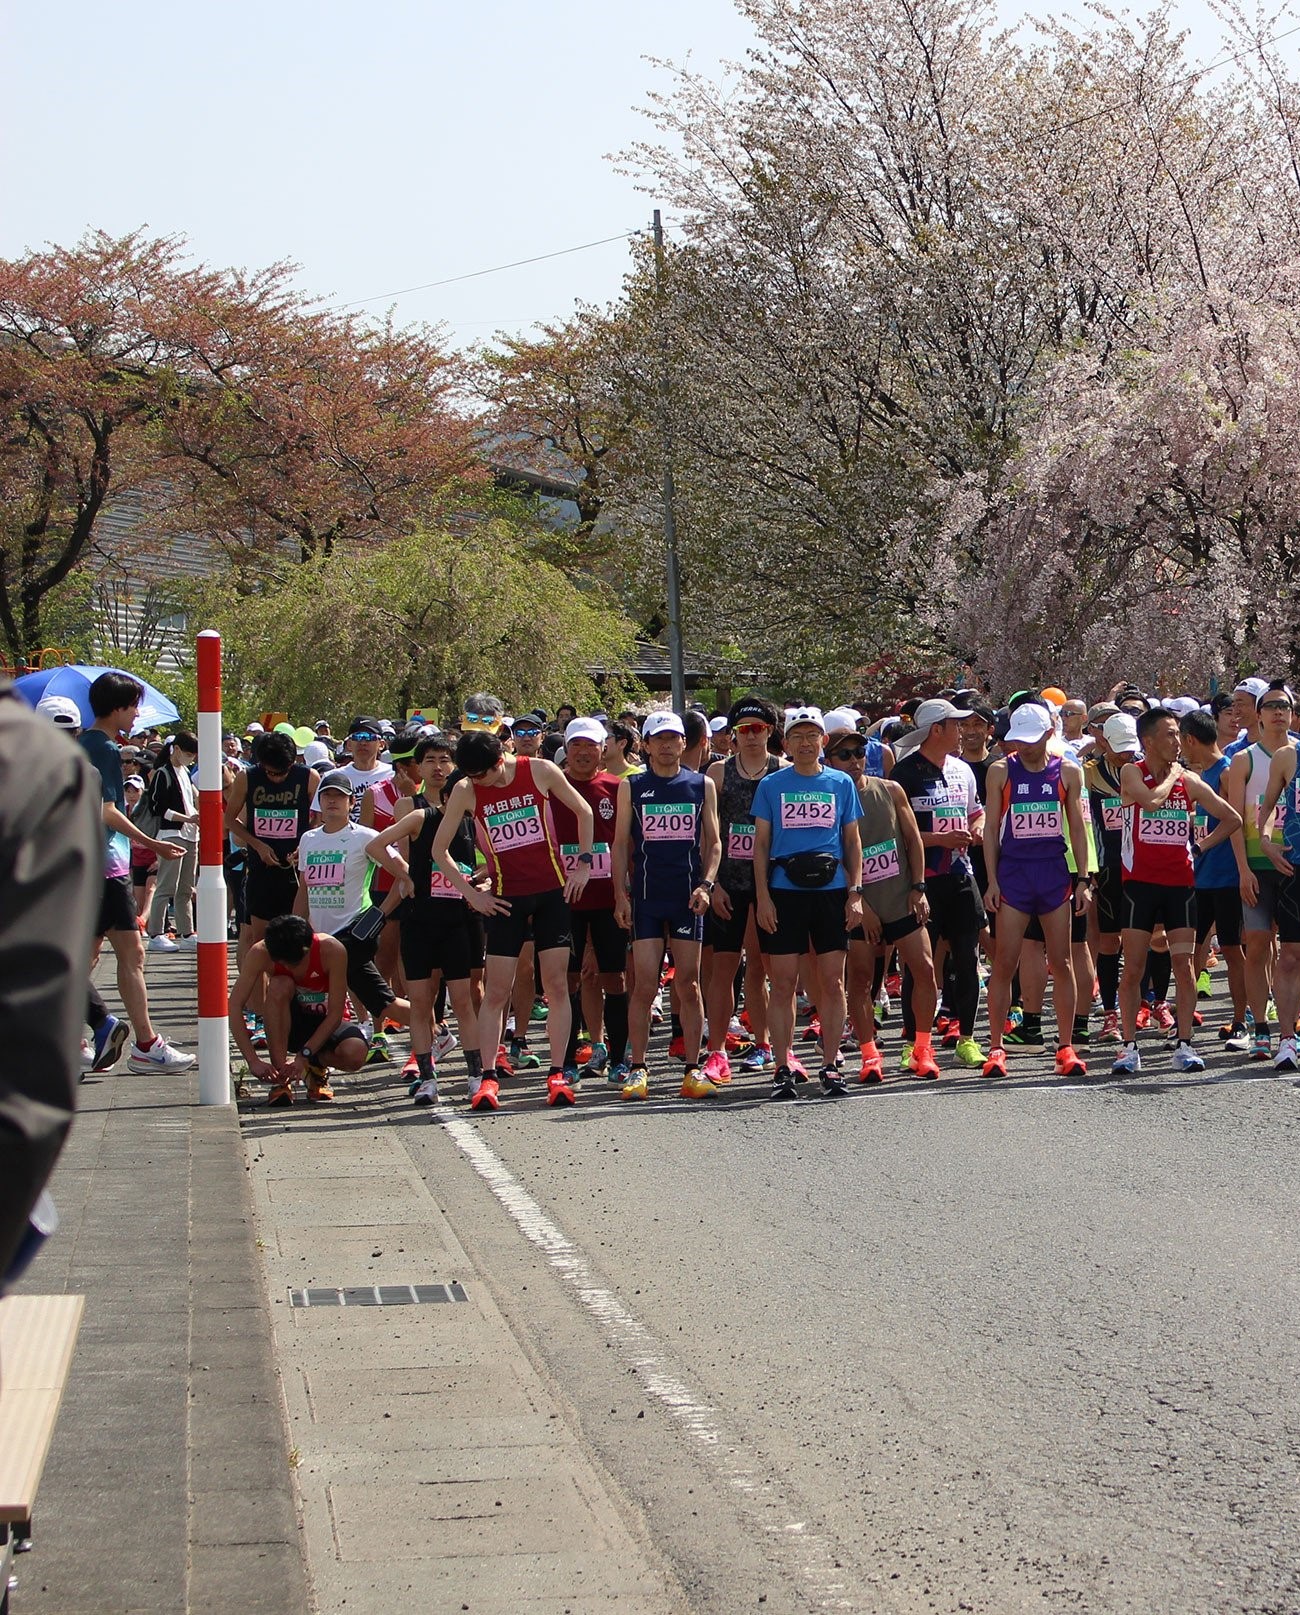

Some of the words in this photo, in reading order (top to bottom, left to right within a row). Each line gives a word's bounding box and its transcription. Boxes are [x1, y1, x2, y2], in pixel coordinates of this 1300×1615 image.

[483, 794, 534, 816] 秋田県庁
[794, 793, 822, 801] ITOKU
[655, 804, 683, 813] ITOKU
[784, 803, 831, 819] 2452
[1022, 802, 1049, 811] ITOKU
[258, 818, 294, 831] 2172
[497, 810, 526, 823] ITOKU
[645, 815, 693, 831] 2409
[1015, 812, 1057, 829] 2145
[490, 817, 540, 843] 2003
[1141, 819, 1187, 836] 2388
[312, 855, 335, 863] ITOKU
[308, 864, 335, 880] 2111
